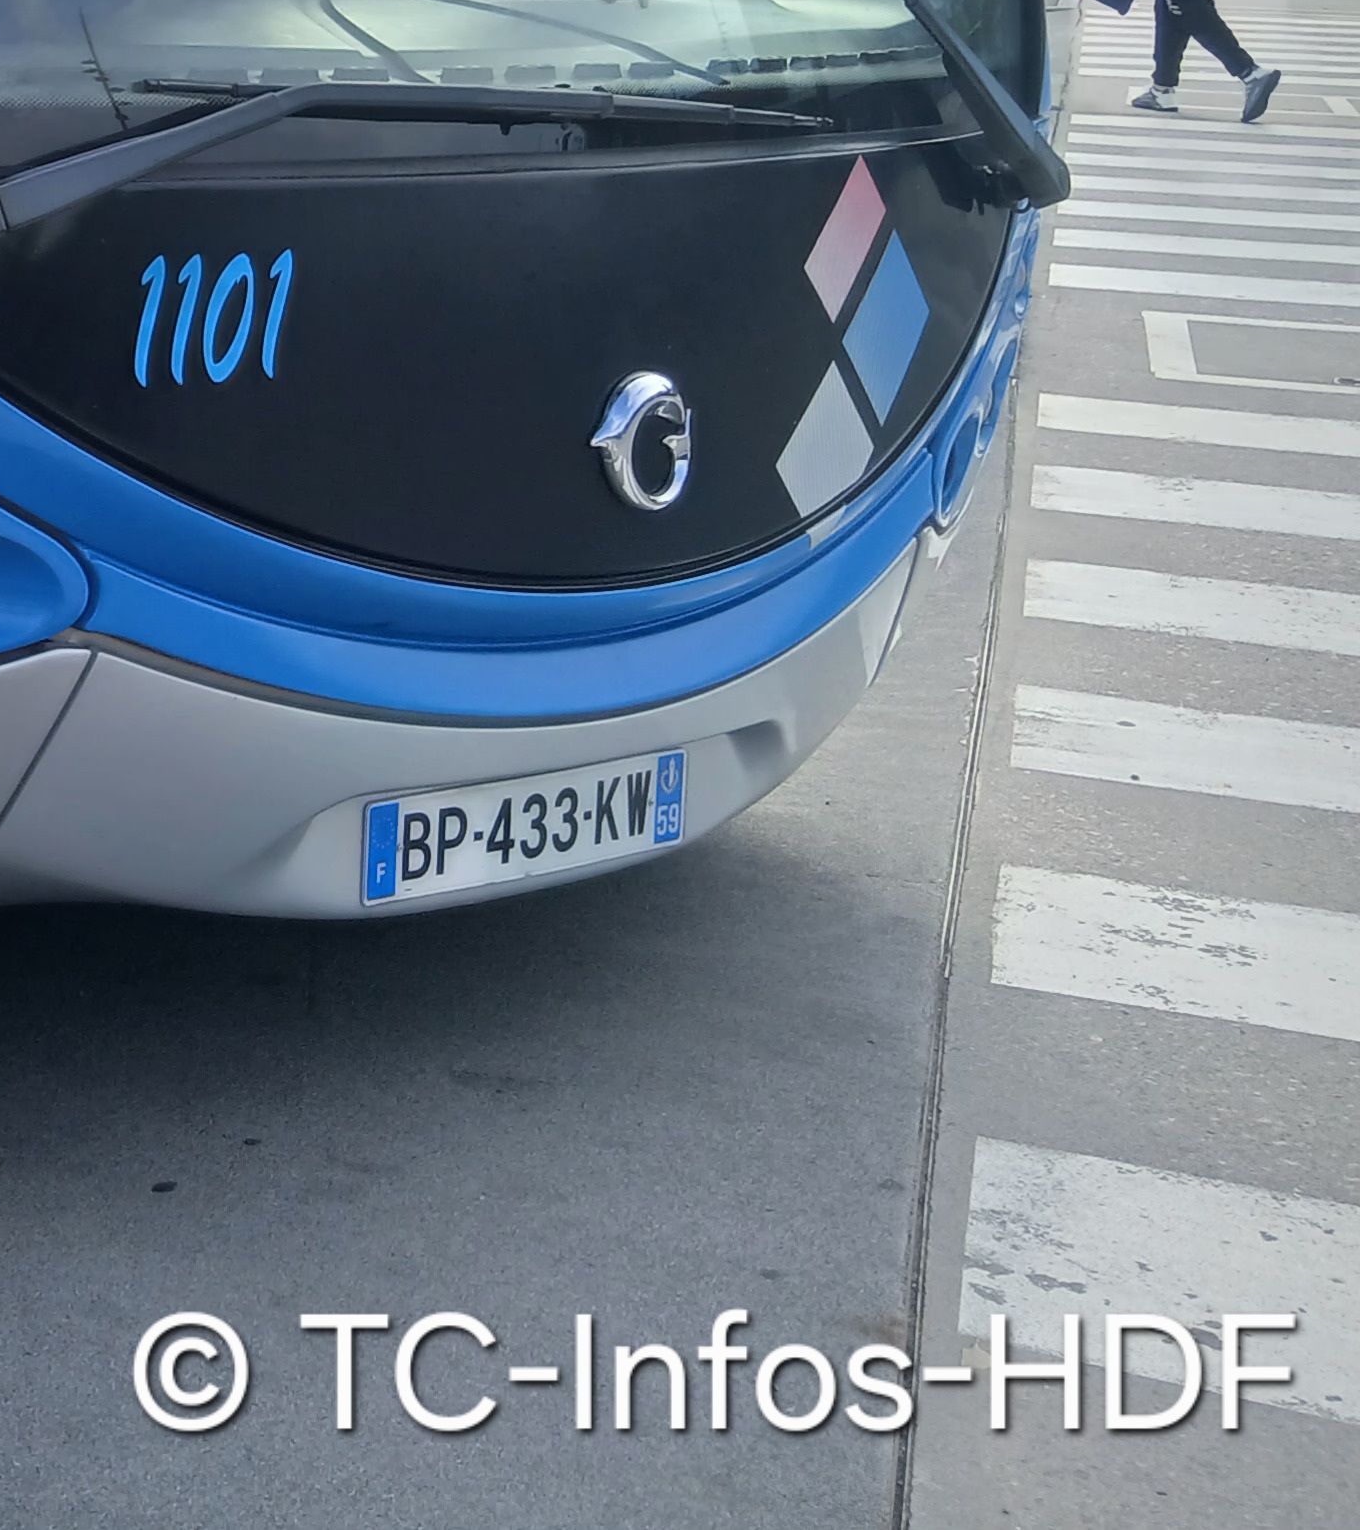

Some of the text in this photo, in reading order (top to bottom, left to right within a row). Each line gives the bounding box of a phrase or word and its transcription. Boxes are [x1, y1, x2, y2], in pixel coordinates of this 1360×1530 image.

[134, 248, 293, 388] 1101
[376, 769, 680, 884] F BP-433-KW 59
